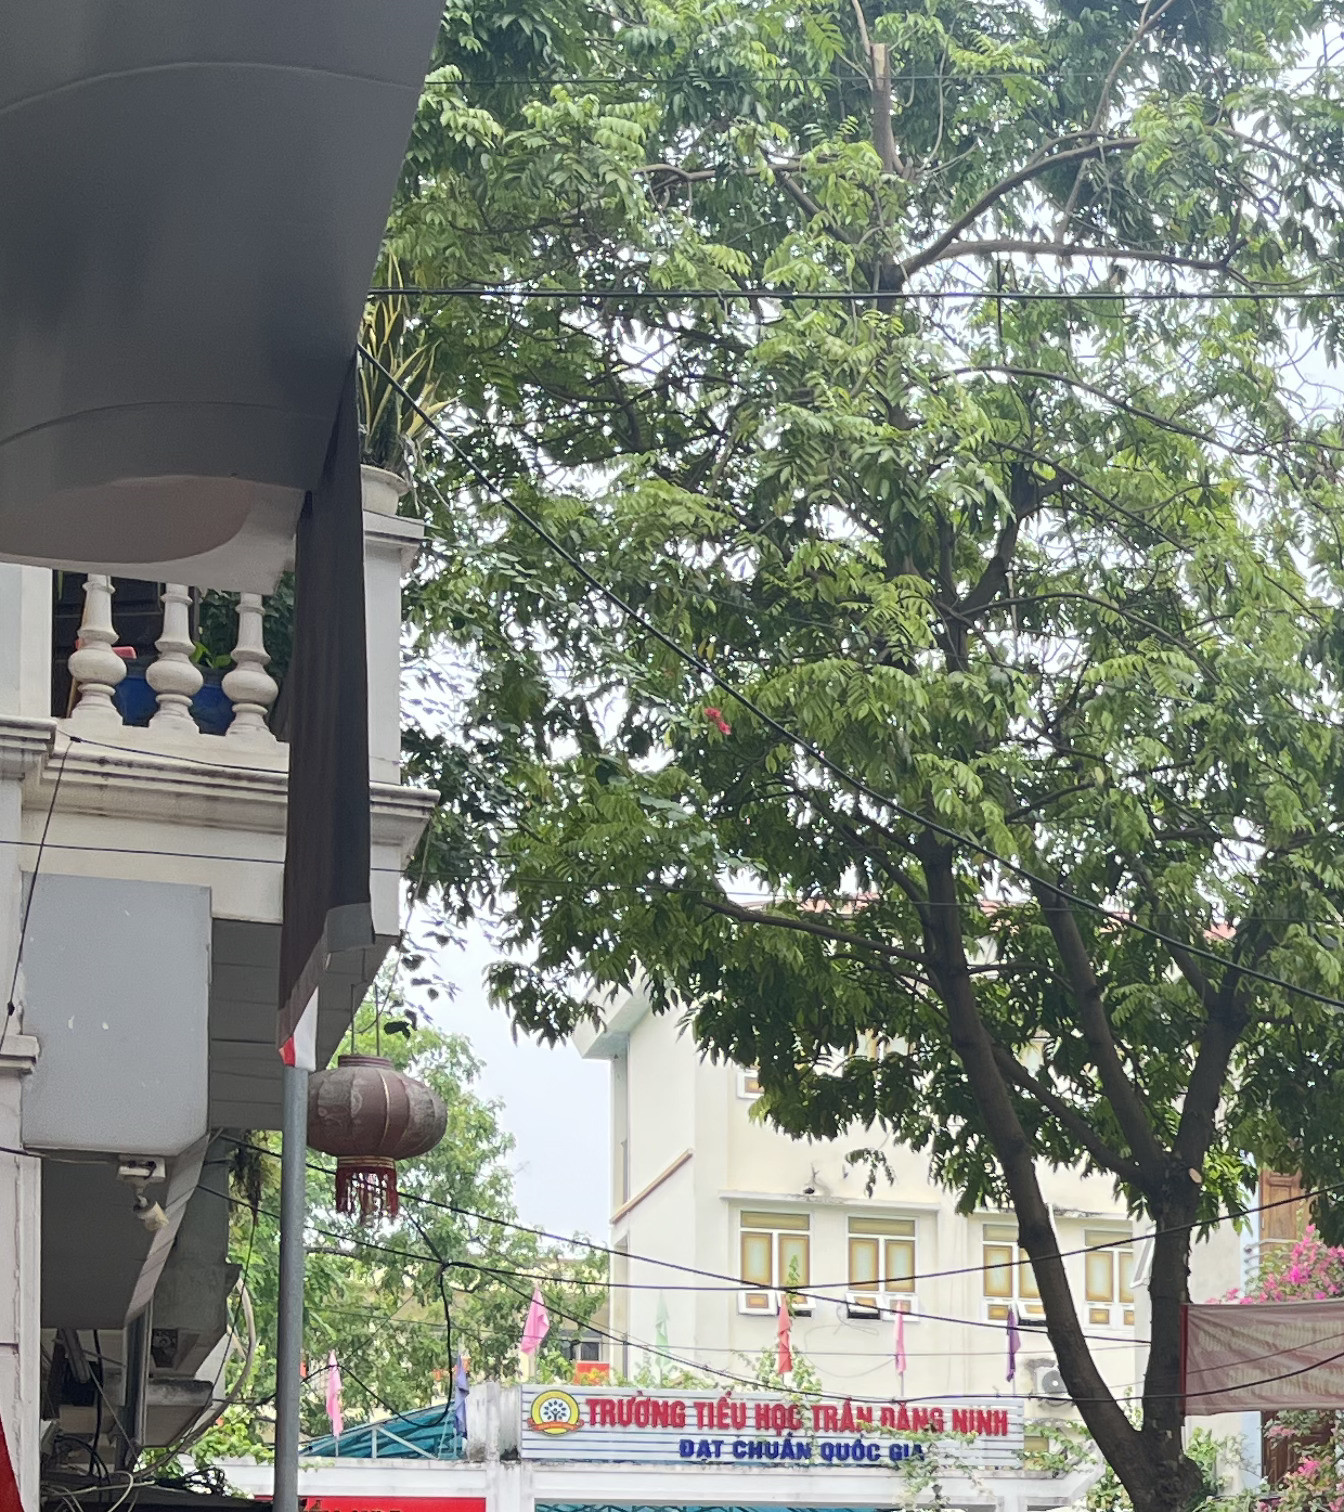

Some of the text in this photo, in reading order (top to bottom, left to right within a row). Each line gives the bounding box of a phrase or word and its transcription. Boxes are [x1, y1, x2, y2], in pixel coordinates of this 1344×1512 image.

[585, 1390, 686, 1429] TRƯỜNG
[693, 1390, 747, 1430] TIỂU
[755, 1403, 803, 1436] HỌC
[812, 1397, 874, 1433] TRẦN
[951, 1408, 1008, 1437] NINH
[679, 1432, 926, 1462] ĐẠT CHUẨN QUỐC GIA
